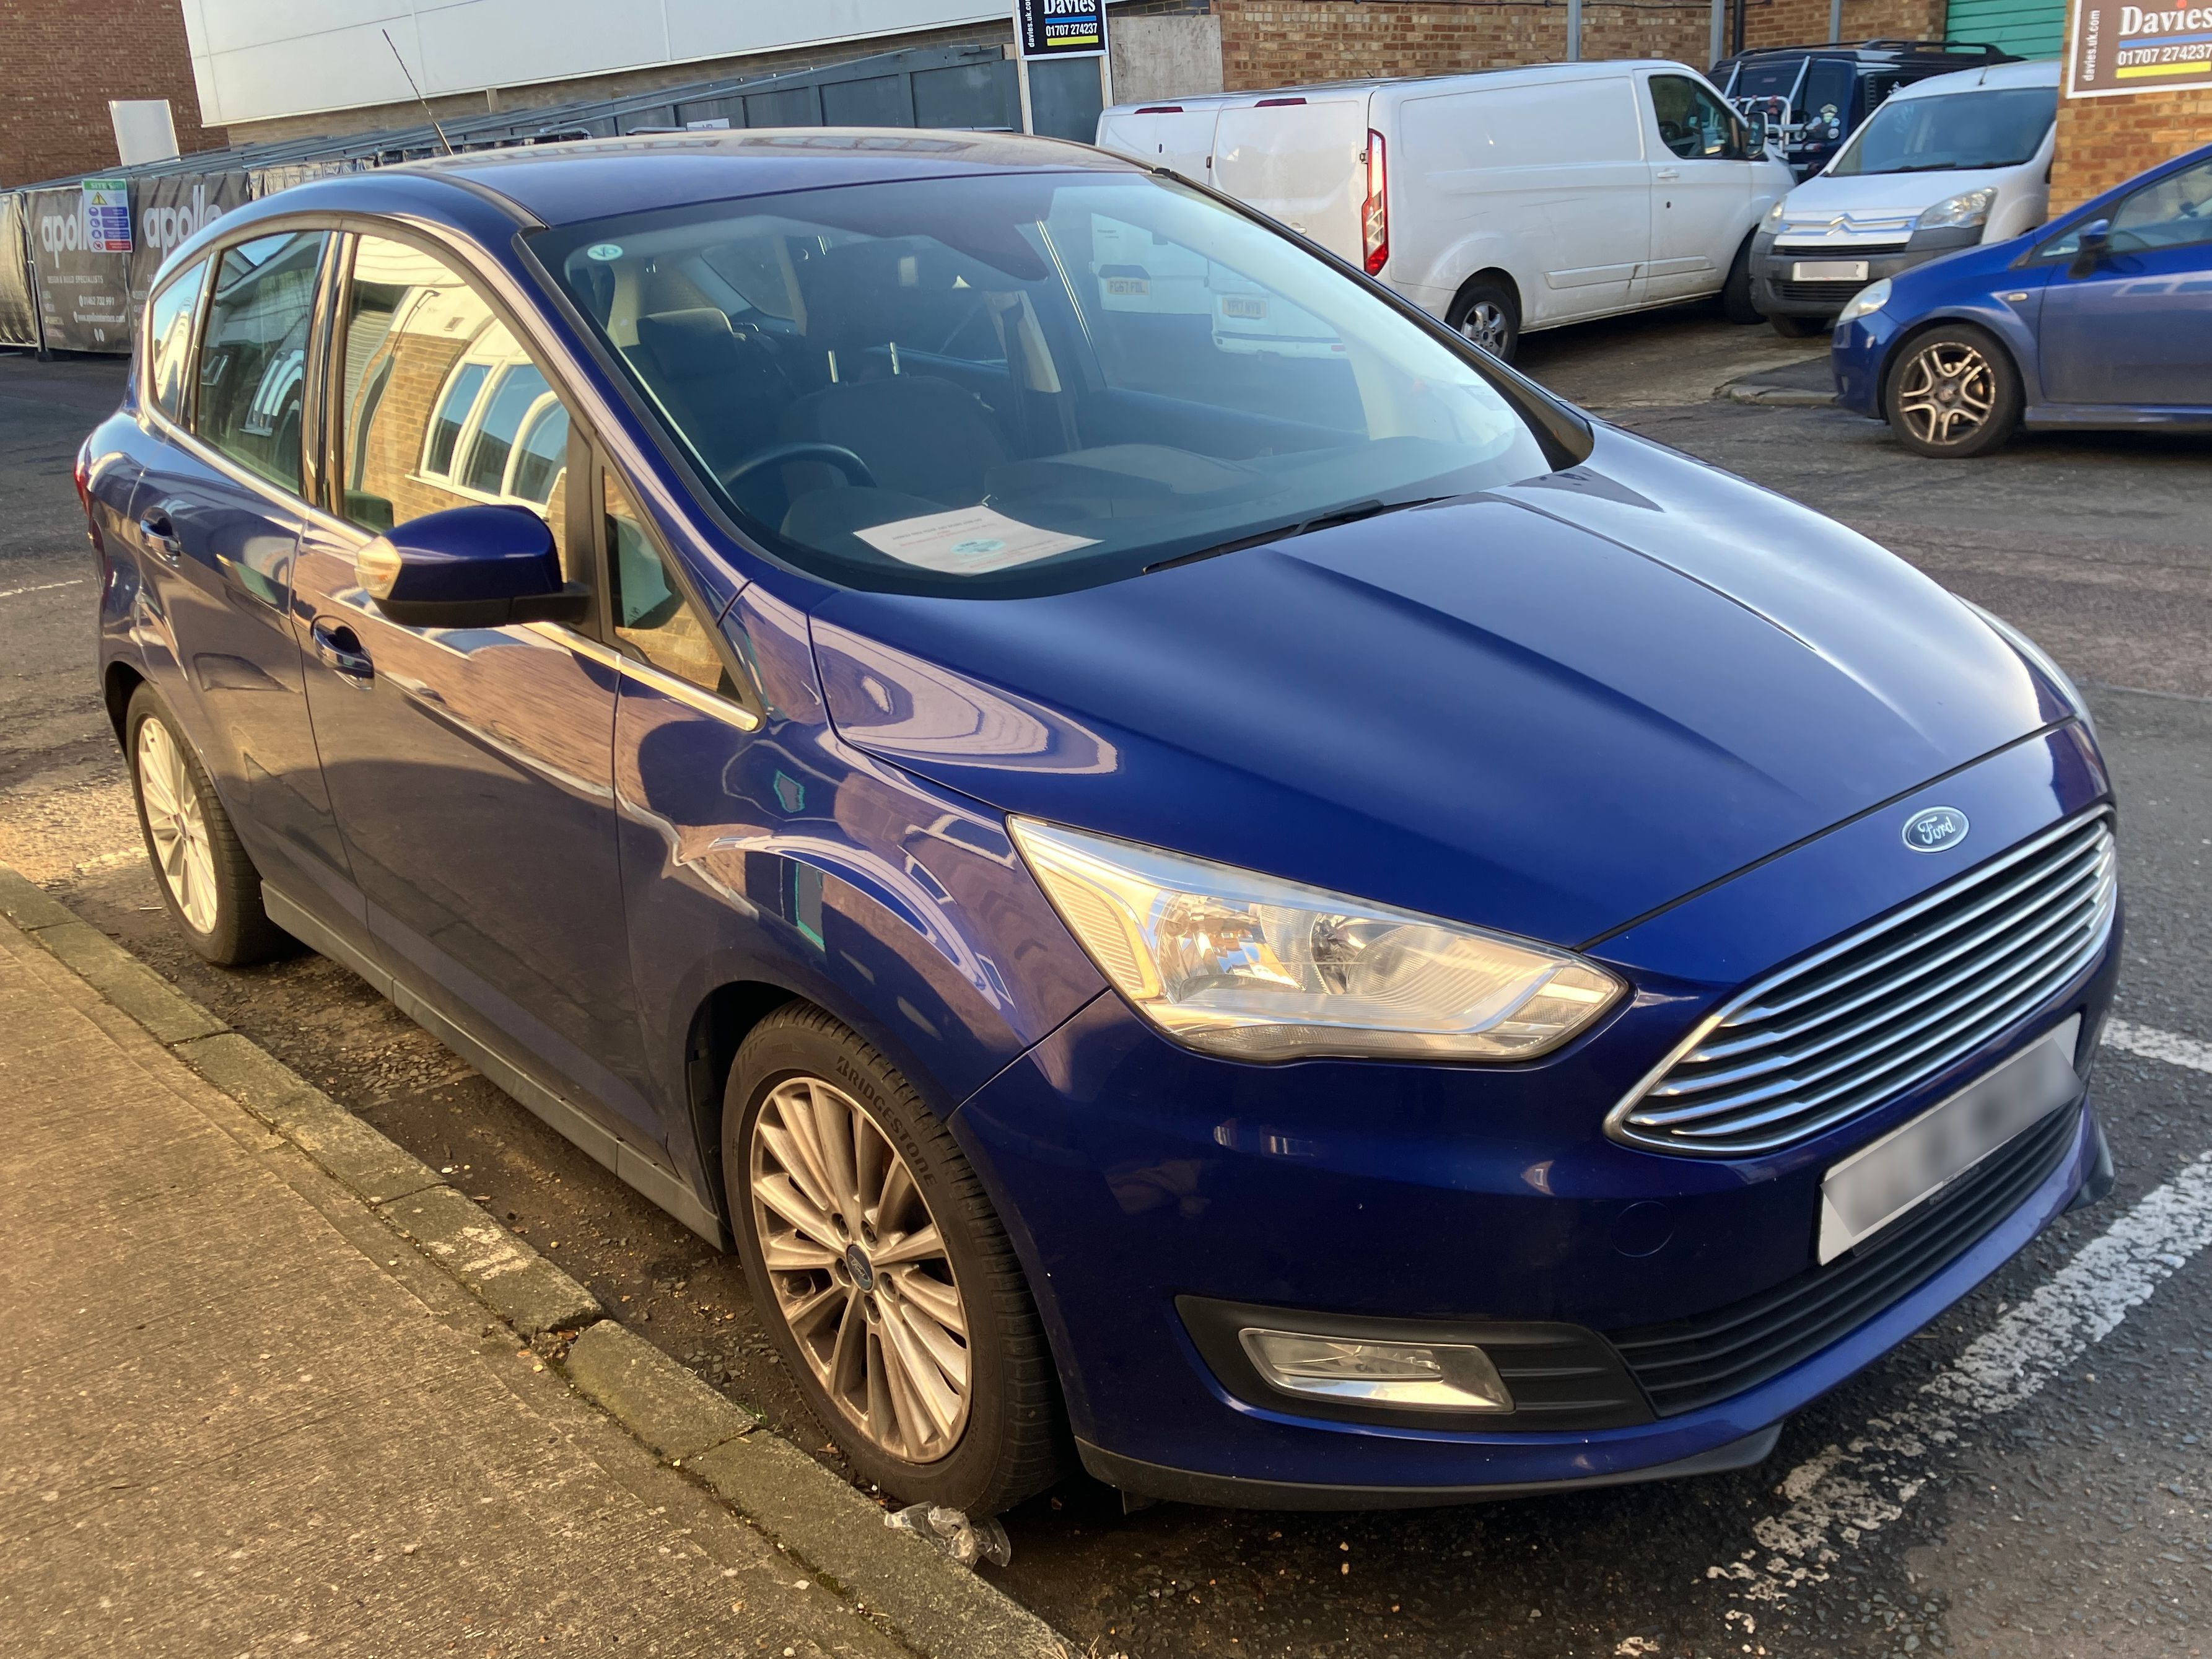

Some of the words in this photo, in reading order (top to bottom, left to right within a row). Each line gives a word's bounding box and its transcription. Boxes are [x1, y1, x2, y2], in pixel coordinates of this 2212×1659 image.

[1044, 0, 1096, 14] Davies
[2118, 0, 2212, 35] Davies
[1025, 0, 1034, 48] davies.uk.co
[1046, 25, 1069, 37] 01707
[1070, 23, 1098, 35] 274237
[2082, 10, 2101, 82] davies.uk.com
[2117, 49, 2160, 66] 01707
[2162, 43, 2212, 62] 274237
[75, 275, 104, 284] SPECIALISTS
[1918, 816, 1956, 844] Ford
[836, 1056, 938, 1187] BRIDGESTONE
